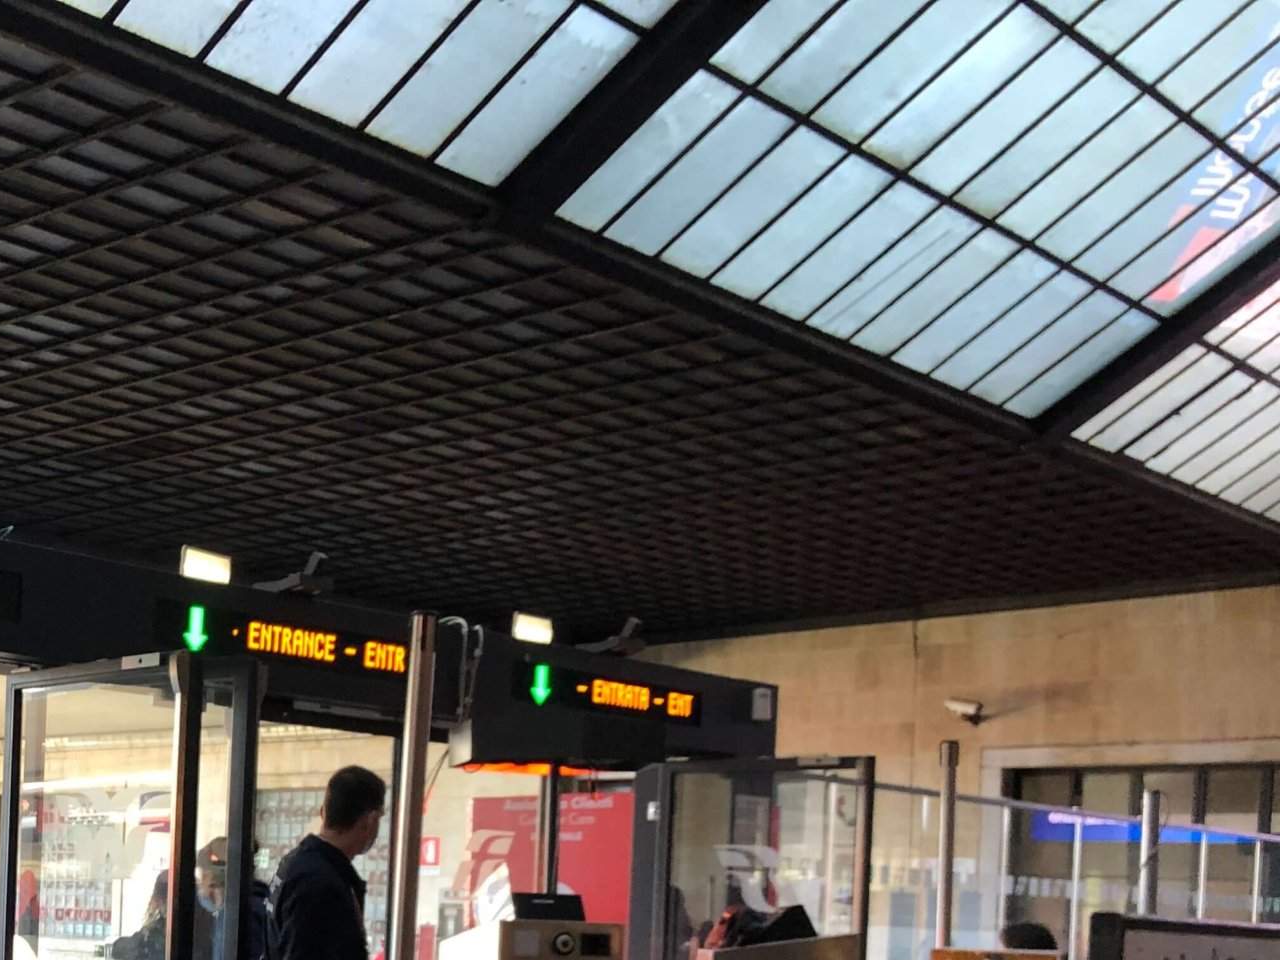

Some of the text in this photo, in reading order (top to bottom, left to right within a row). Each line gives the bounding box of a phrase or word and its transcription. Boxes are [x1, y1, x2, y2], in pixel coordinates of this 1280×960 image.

[247, 621, 337, 662] ENTRANCE
[363, 641, 406, 673] ENTR
[591, 679, 650, 711] ENTRATA
